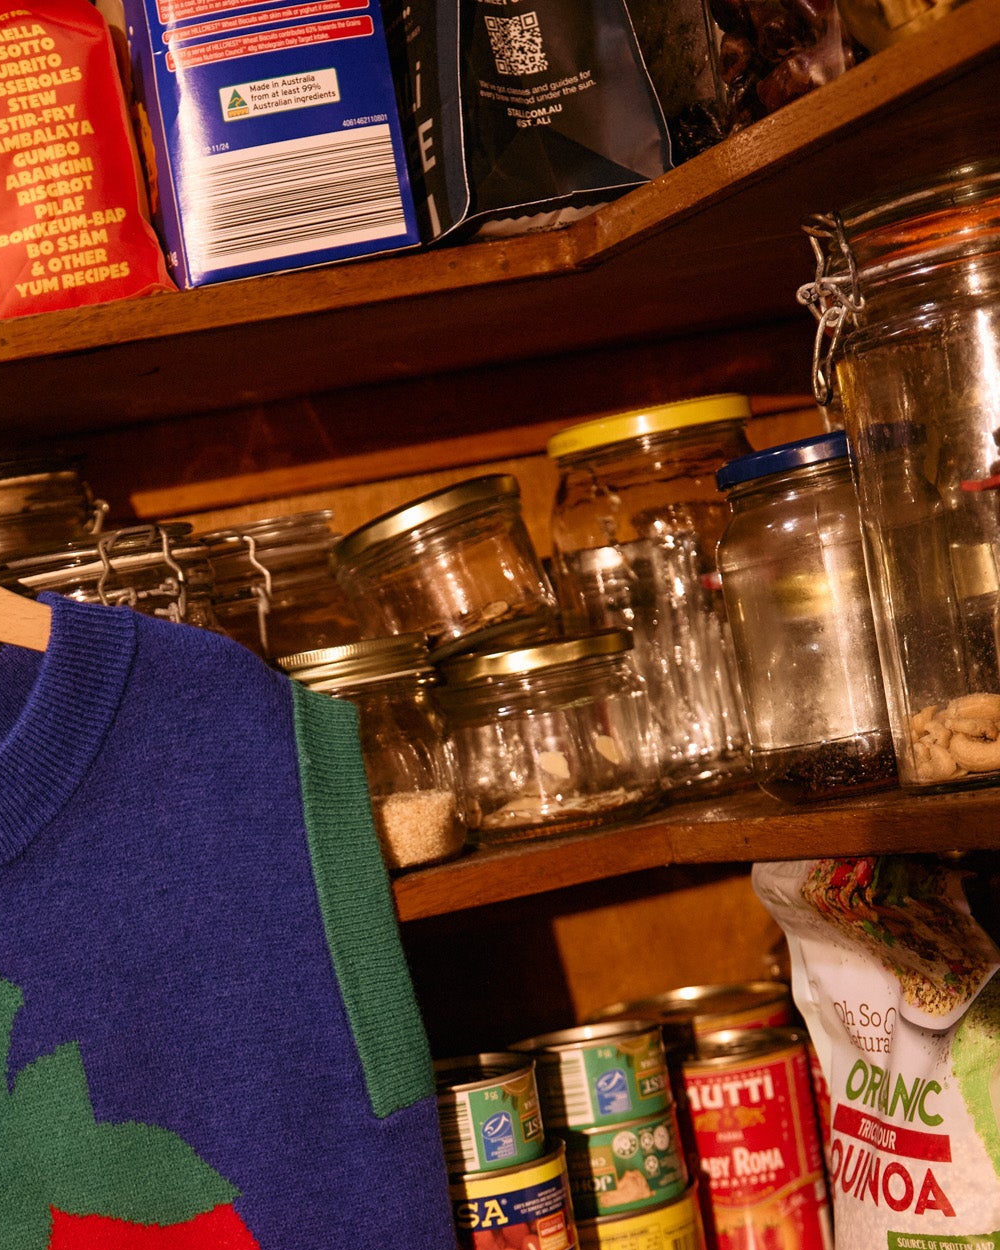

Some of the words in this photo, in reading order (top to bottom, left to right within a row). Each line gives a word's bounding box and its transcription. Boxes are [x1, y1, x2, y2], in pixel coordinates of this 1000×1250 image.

[250, 83, 270, 92] Made
[281, 75, 316, 87] Australia
[251, 93, 269, 102] from
[271, 90, 280, 98] at
[281, 87, 300, 96] least
[301, 83, 322, 93] 99%
[532, 84, 549, 94] and
[549, 75, 579, 90] guides
[579, 69, 591, 80] for
[536, 90, 561, 102] under
[562, 85, 577, 95] the
[578, 79, 597, 90] sun.
[7, 89, 57, 113] STEW
[253, 98, 293, 111] Australian
[294, 90, 336, 103] ingredients
[12, 141, 80, 168] GUMBO
[5, 156, 94, 191] ARANCINI
[34, 195, 85, 220] PILAF
[26, 240, 55, 259] BO
[31, 260, 45, 277] &
[47, 248, 108, 272] OTHER
[15, 275, 60, 298] YUM
[61, 261, 130, 290] RECIPES
[859, 1003, 882, 1027] So
[731, 1146, 785, 1177] ROMA
[897, 1237, 928, 1249] SOURCE
[928, 1240, 938, 1250] OF
